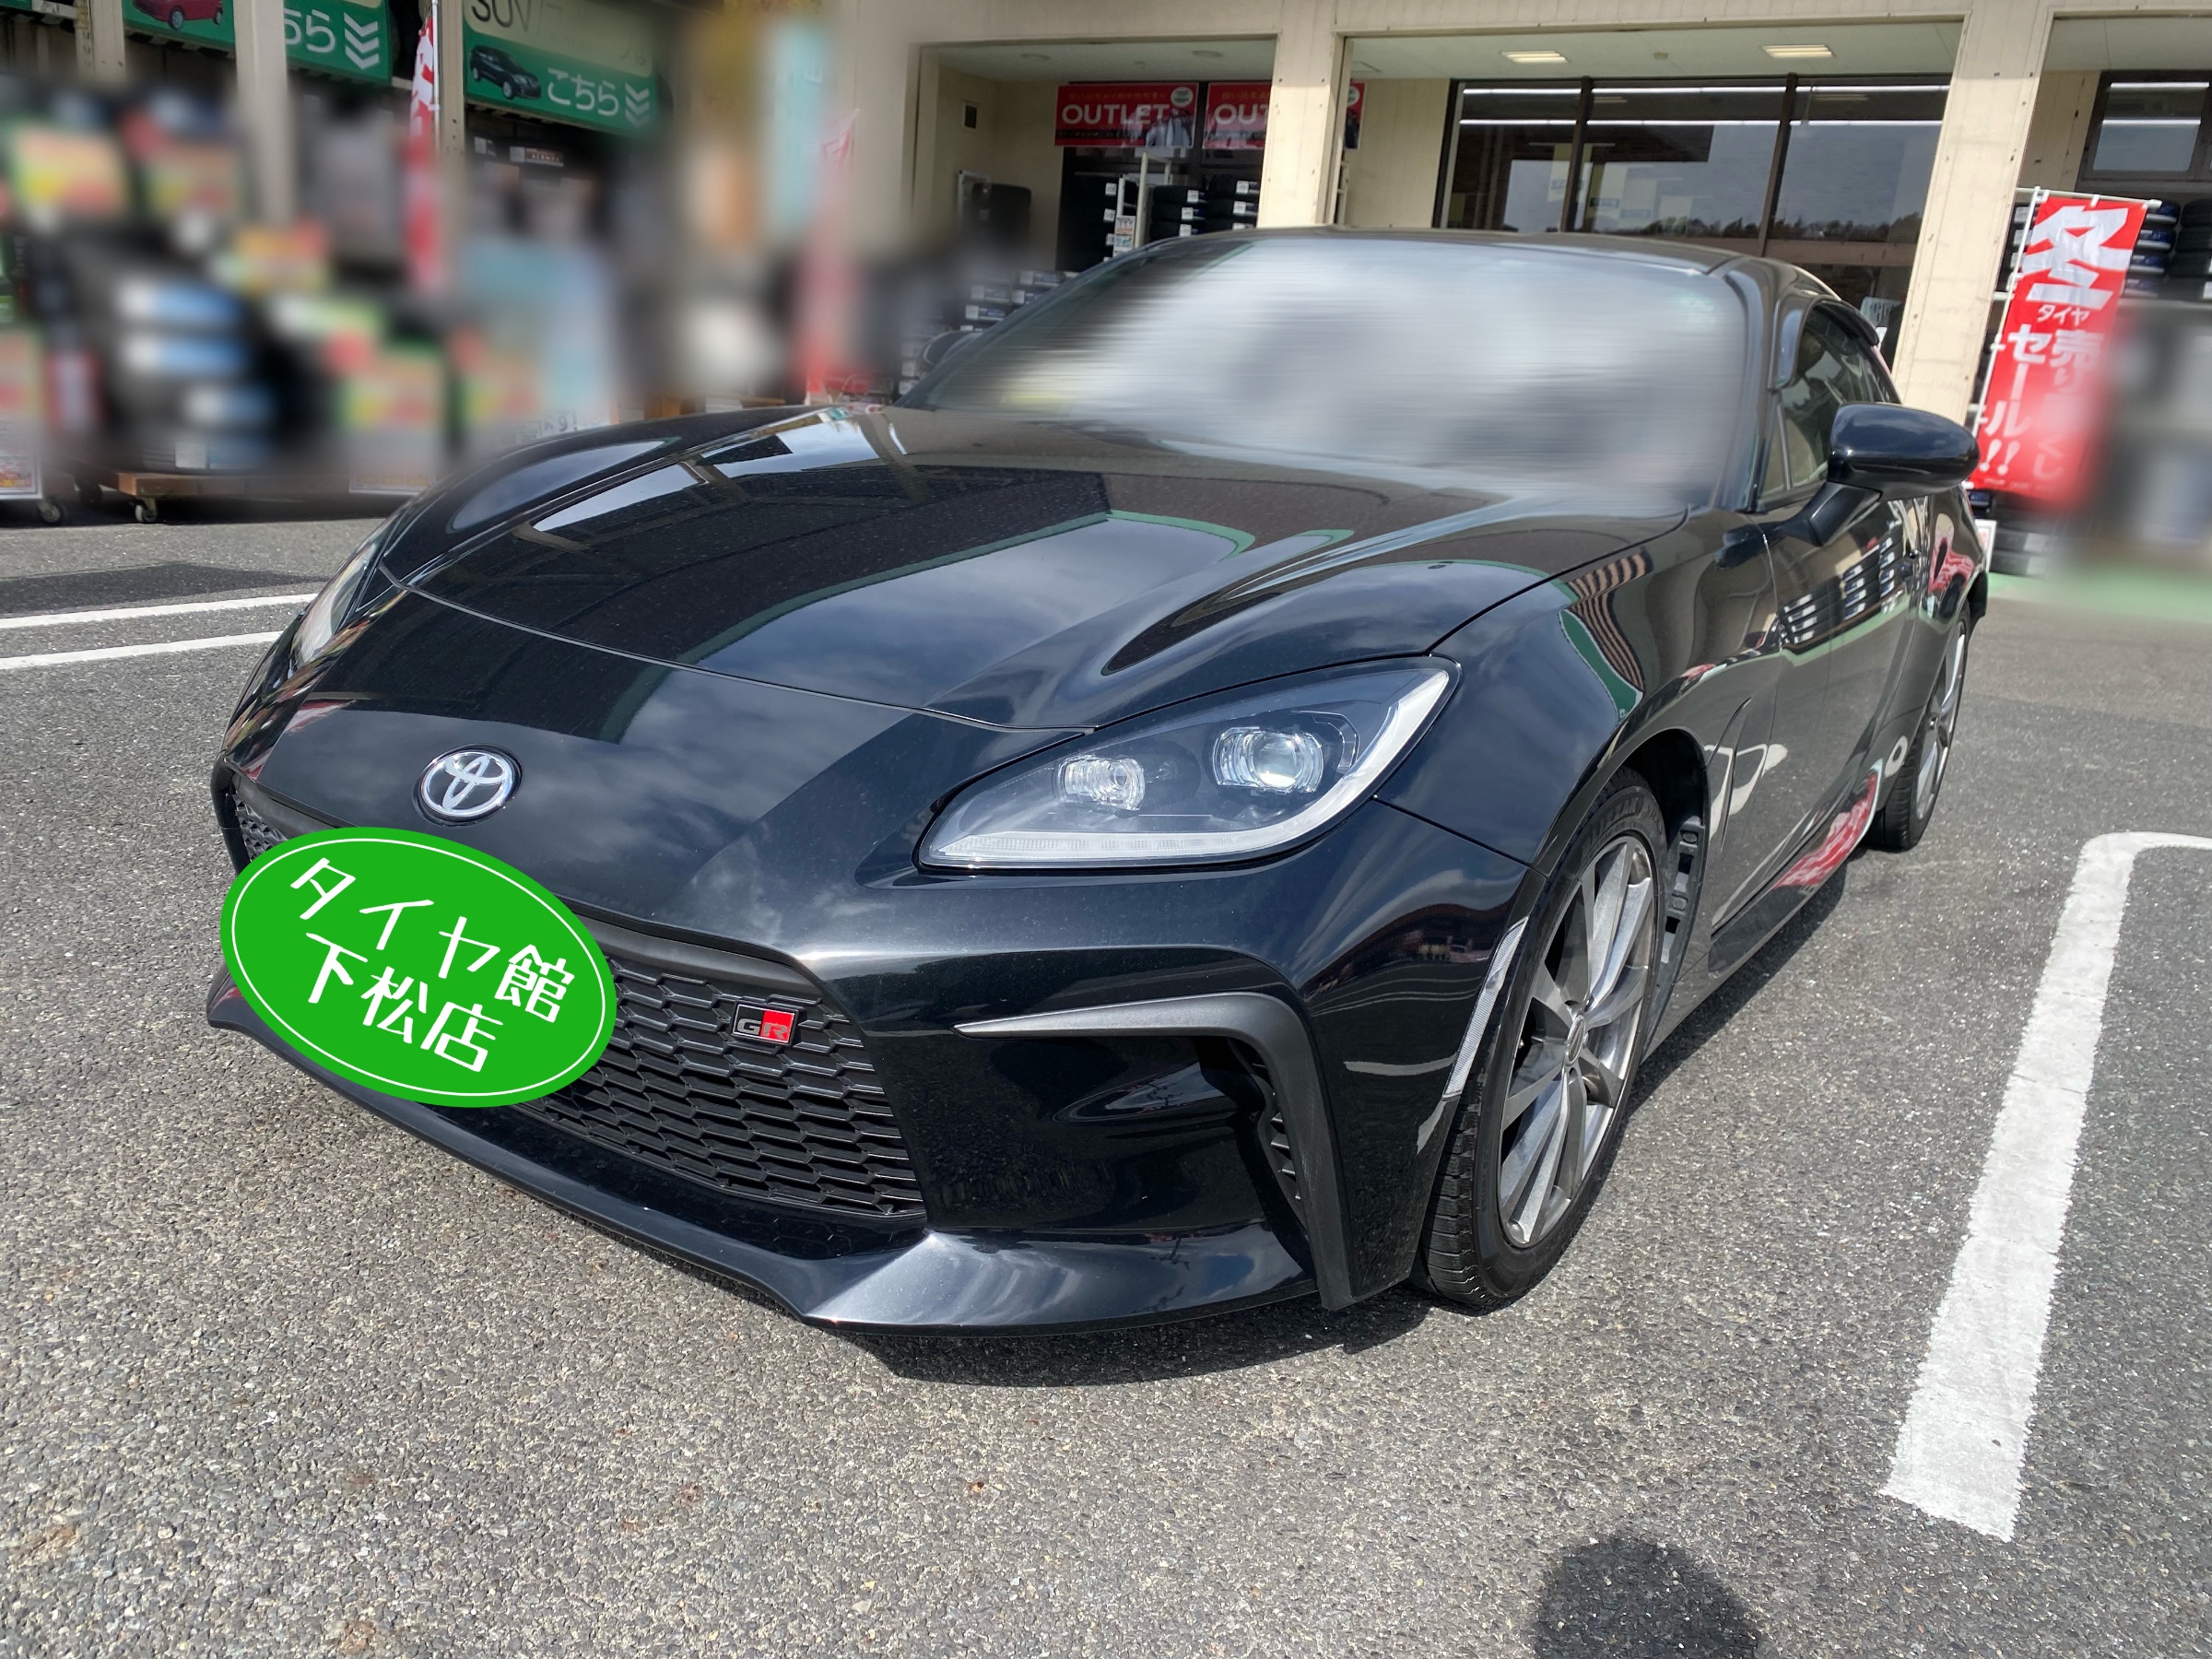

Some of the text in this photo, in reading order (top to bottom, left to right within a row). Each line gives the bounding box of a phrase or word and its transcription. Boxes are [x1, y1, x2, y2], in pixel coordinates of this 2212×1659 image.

[547, 66, 620, 117] こちら
[1061, 102, 1171, 125] OUTLET
[2021, 205, 2134, 312] 冬
[2037, 303, 2092, 327] タイヤ
[2031, 328, 2106, 482] 売りくし
[737, 1018, 788, 1040] GR
